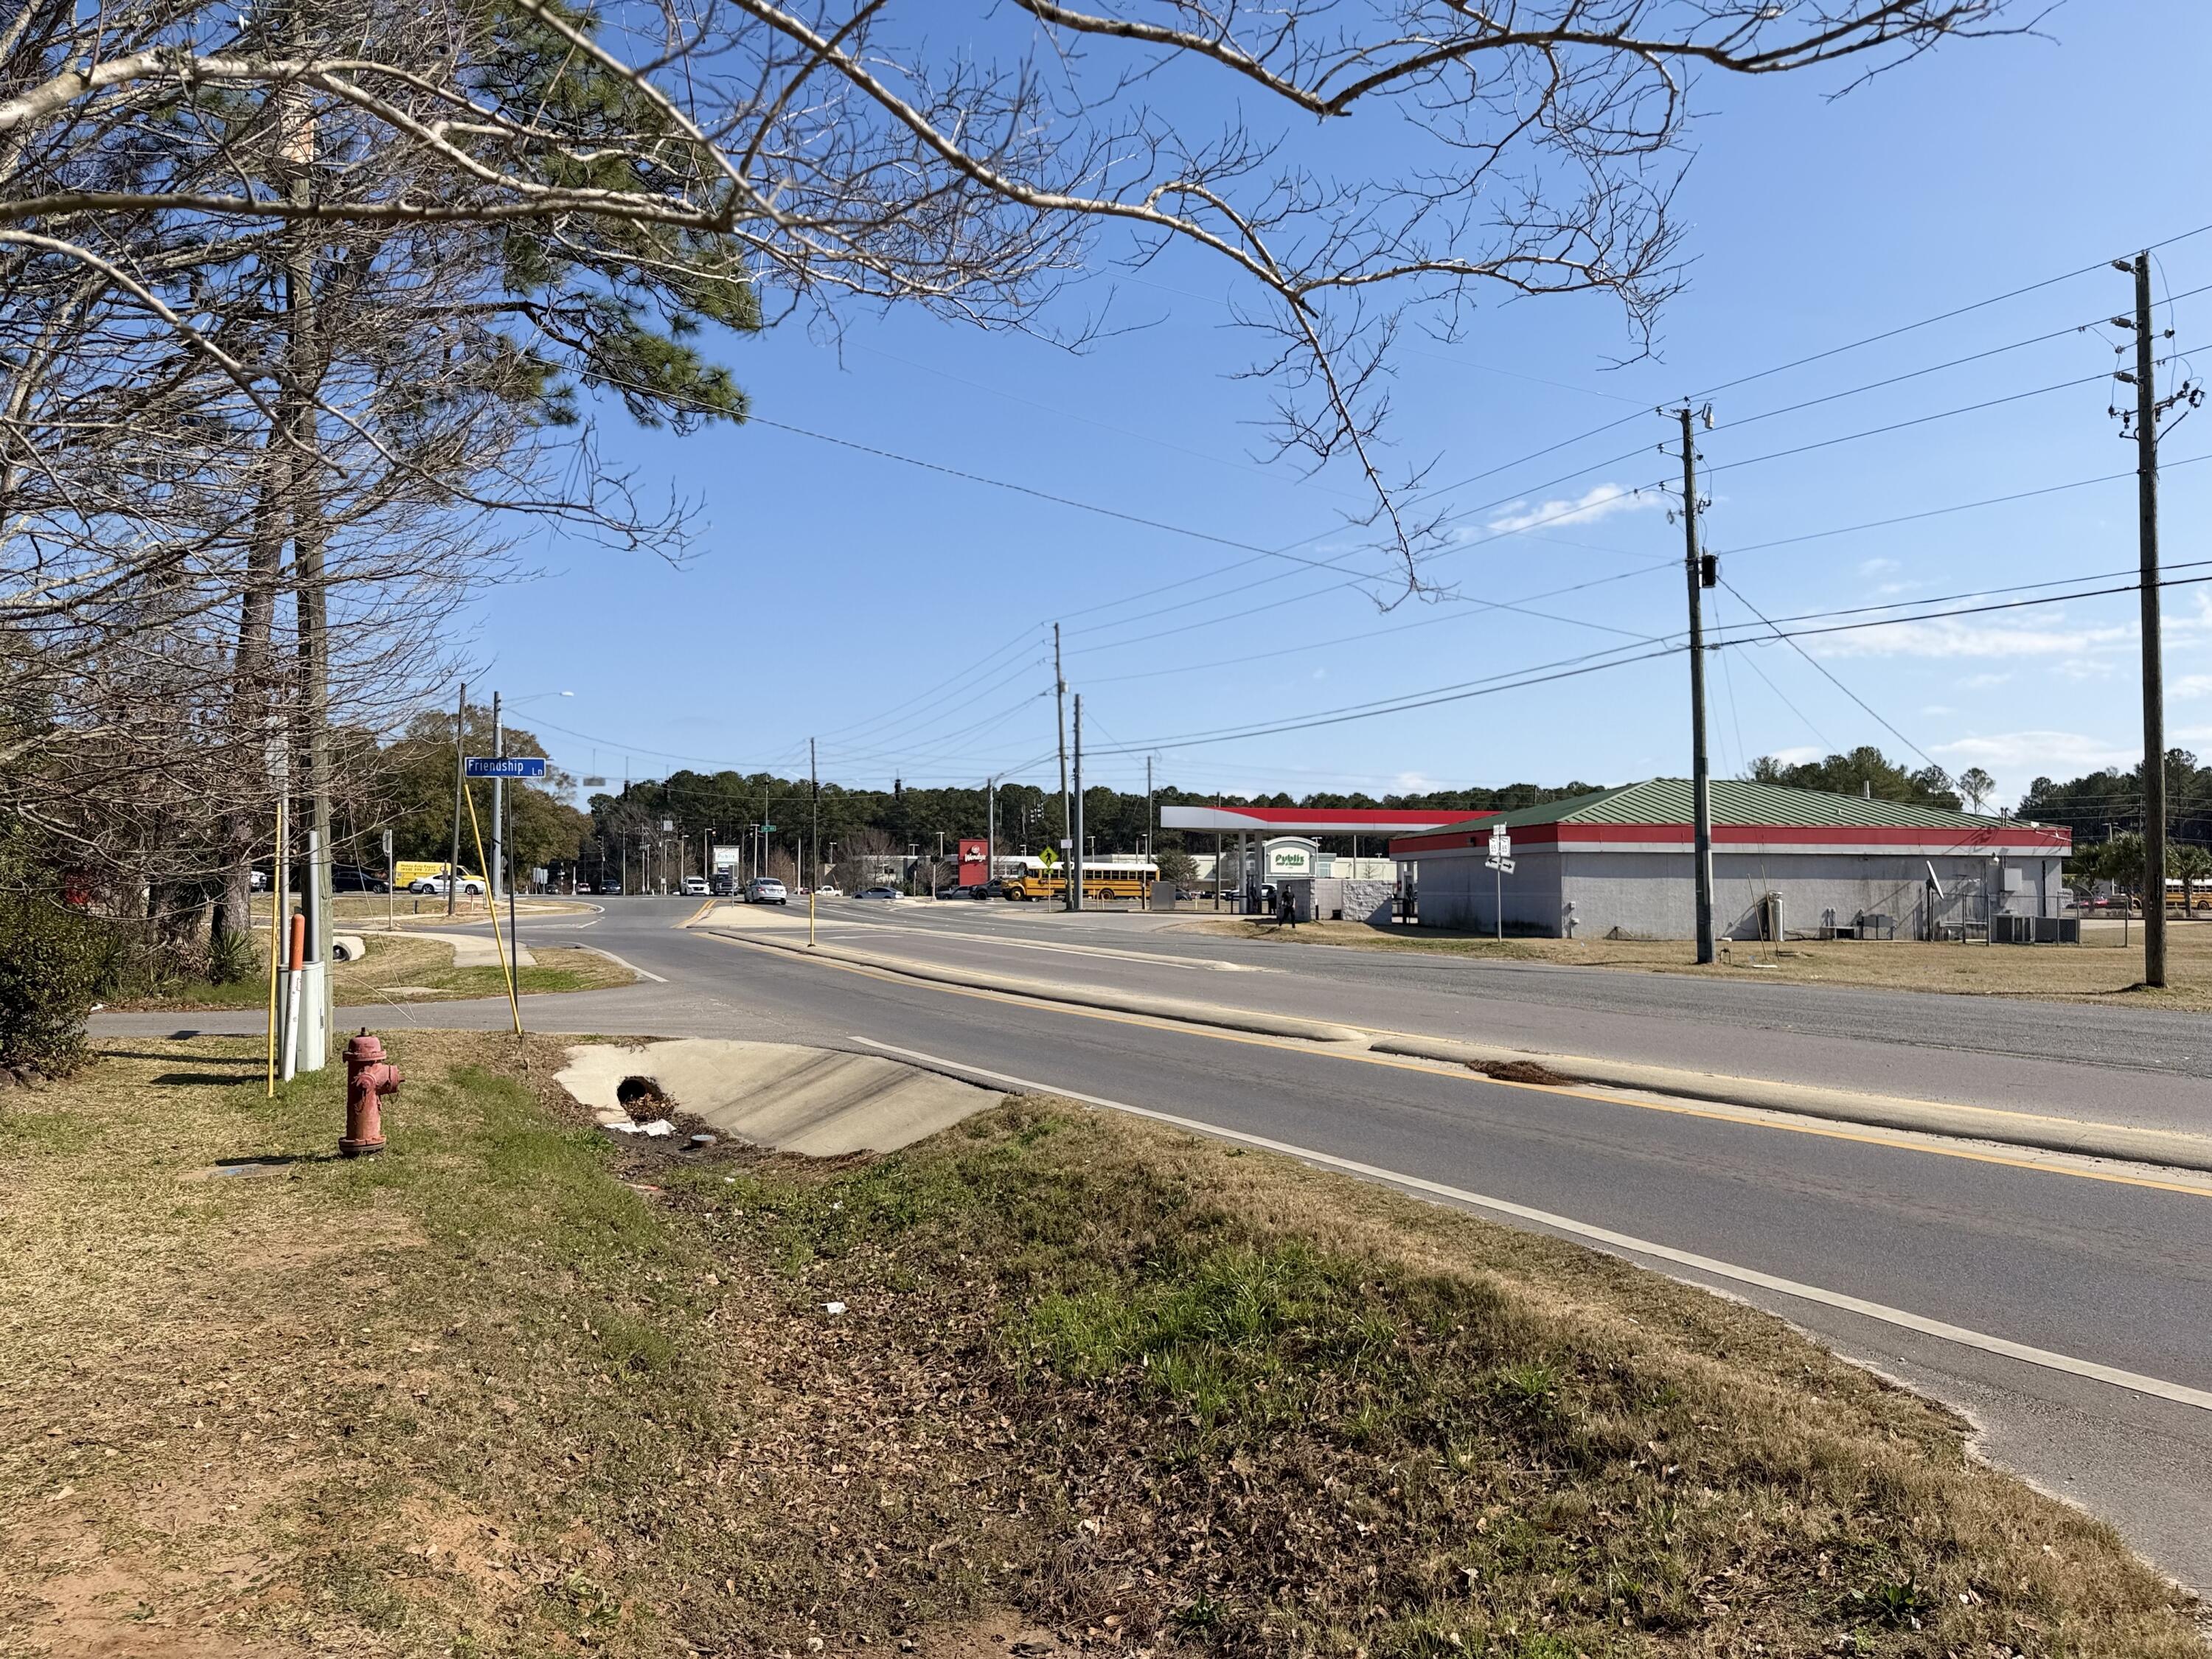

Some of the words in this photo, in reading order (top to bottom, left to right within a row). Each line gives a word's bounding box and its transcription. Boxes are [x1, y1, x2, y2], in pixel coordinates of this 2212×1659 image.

[467, 759, 524, 775] Friendship
[532, 767, 543, 776] Ln
[1501, 844, 1508, 853] 85
[1275, 854, 1305, 862] Publix
